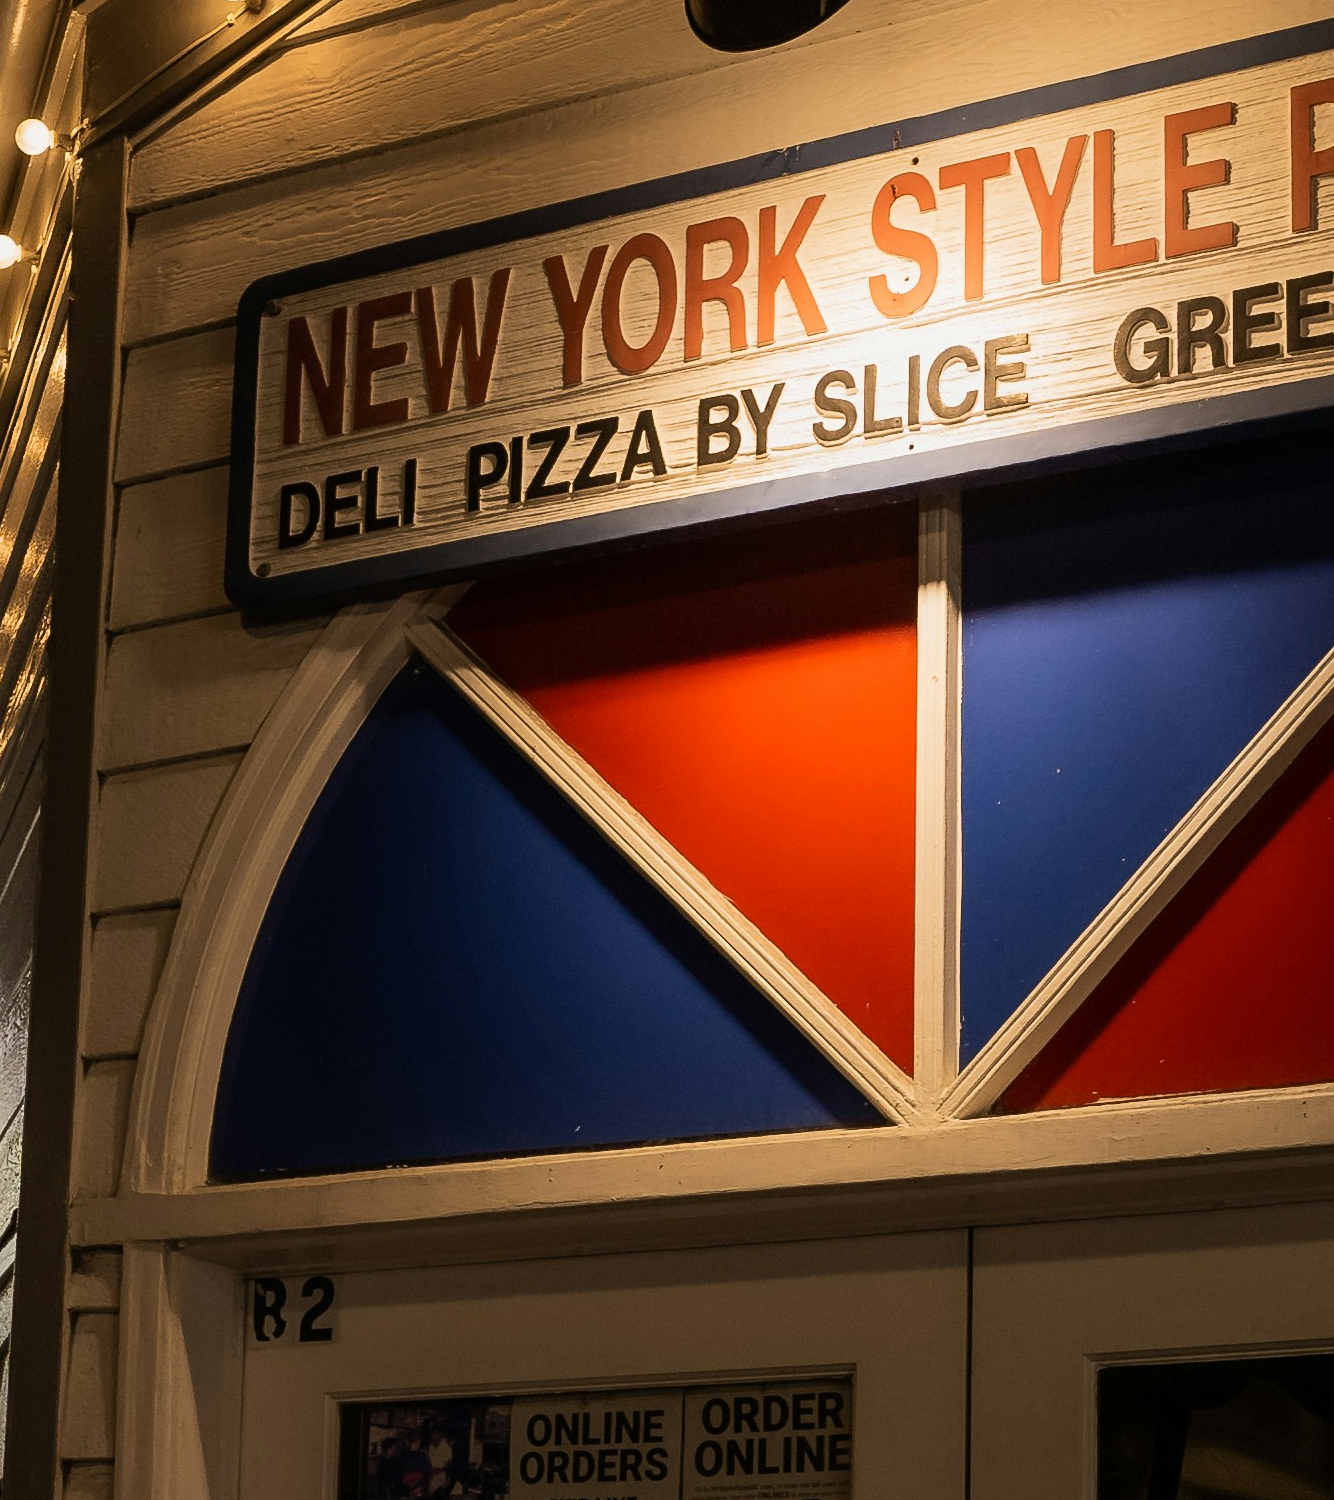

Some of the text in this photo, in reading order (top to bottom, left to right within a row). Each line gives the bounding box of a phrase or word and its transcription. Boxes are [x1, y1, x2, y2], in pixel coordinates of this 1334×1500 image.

[282, 267, 512, 446] NEW
[542, 194, 828, 389] YORK
[869, 102, 1237, 319] STYLE
[278, 458, 416, 550] DELI
[468, 409, 668, 513] PIZZA
[696, 382, 786, 470] BY
[812, 333, 1030, 446] SLICE
[525, 1409, 665, 1447] ONLINE
[701, 1392, 844, 1435] ORDER
[519, 1447, 668, 1485] ORDERS
[694, 1433, 852, 1478] ONLINE
